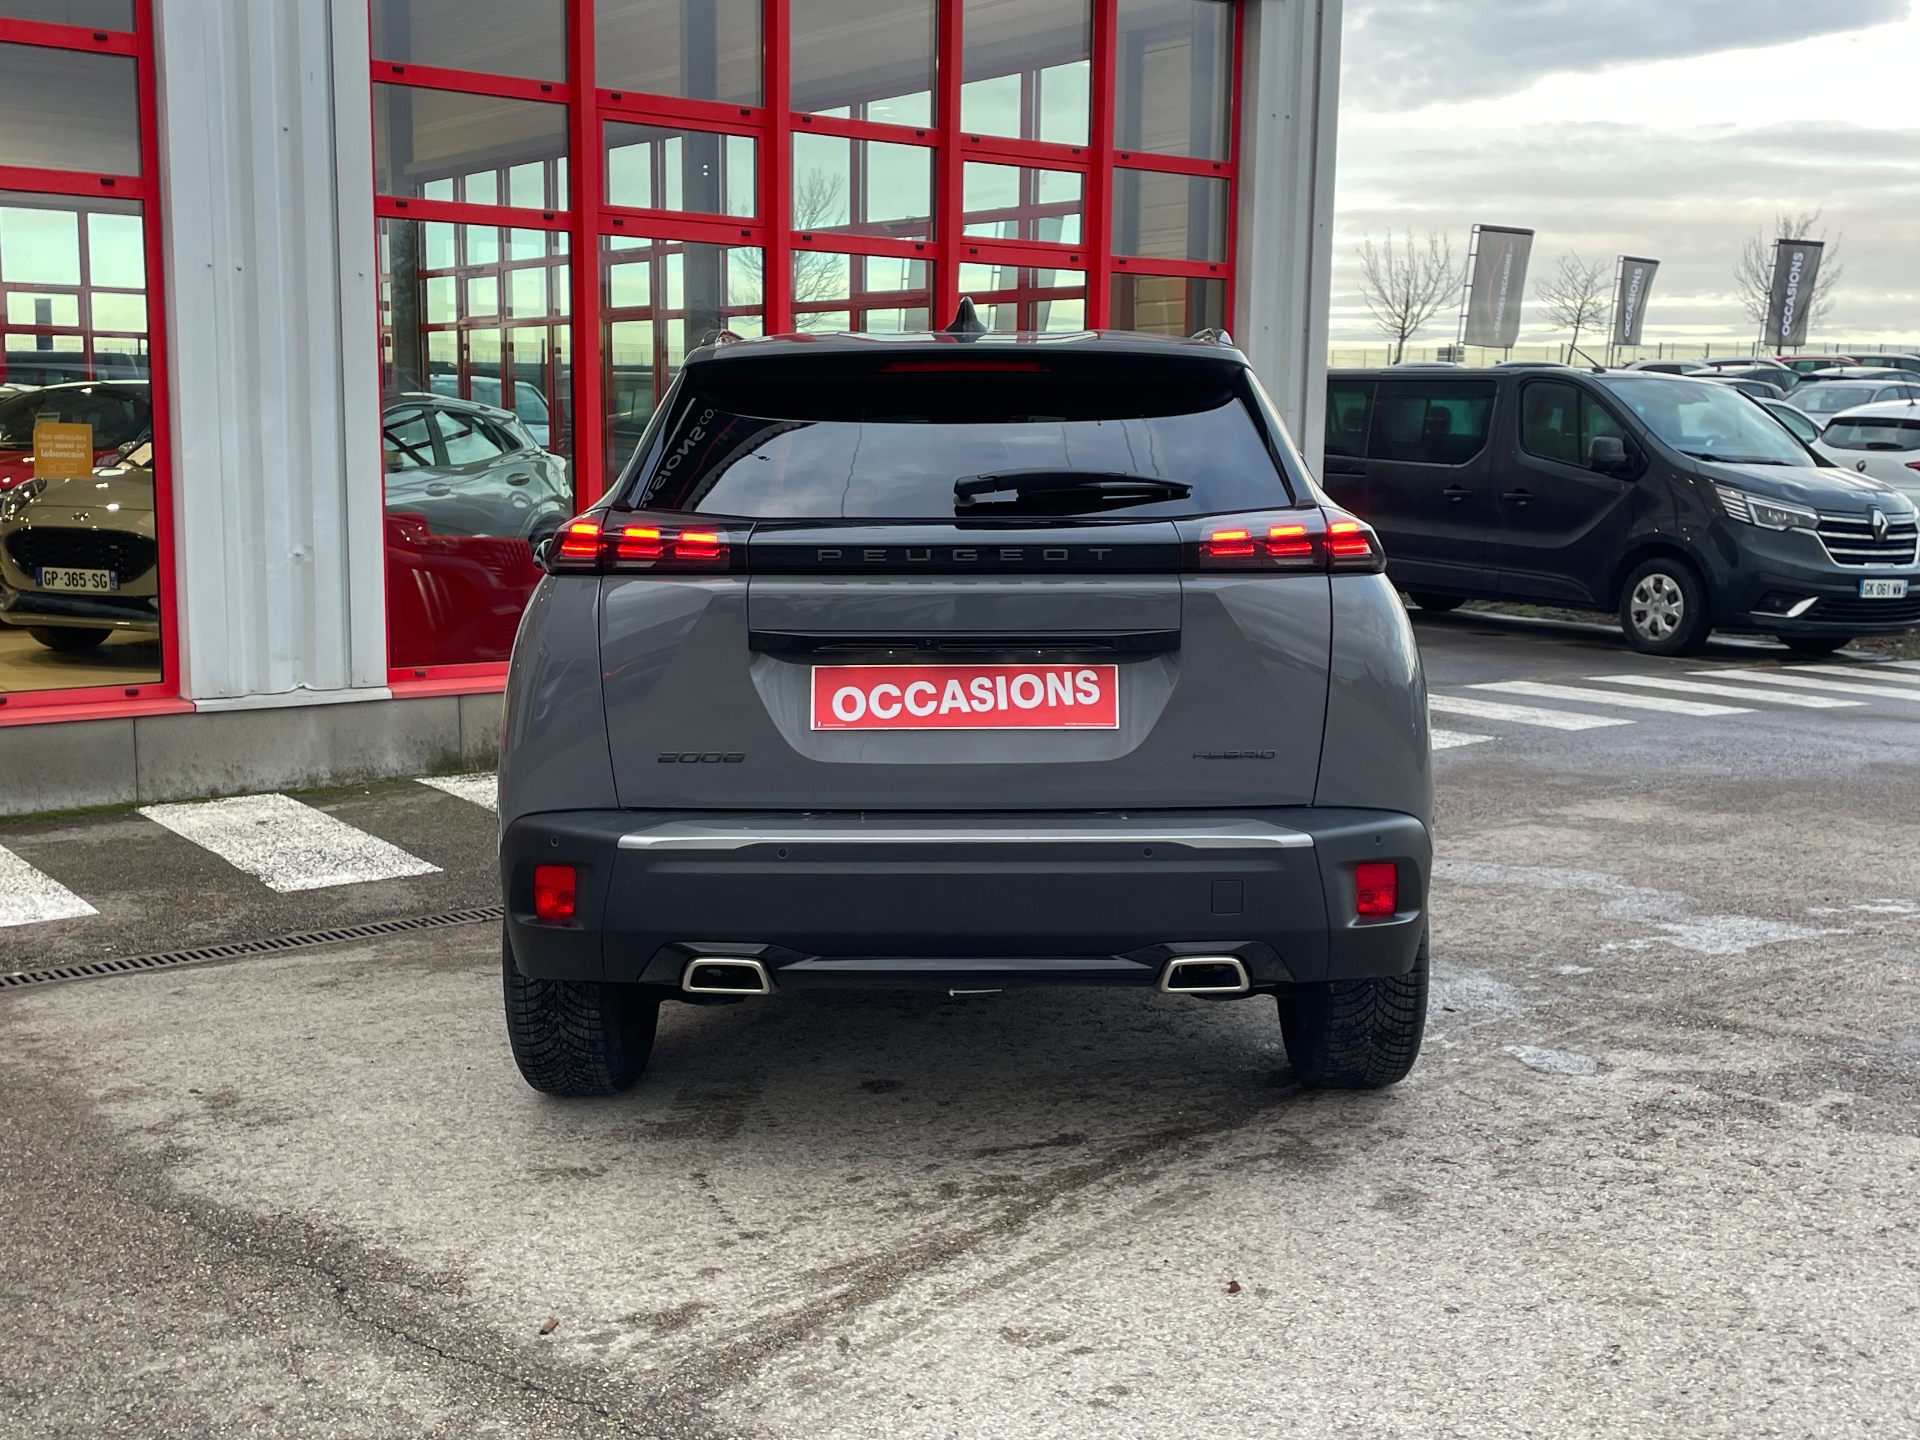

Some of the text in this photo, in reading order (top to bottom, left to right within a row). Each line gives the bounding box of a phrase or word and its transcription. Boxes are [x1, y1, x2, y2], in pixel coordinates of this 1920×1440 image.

[1500, 253, 1513, 296] OCCASIONS
[1781, 251, 1804, 336] OCCASIONS
[1624, 267, 1643, 337] OCCASIONS
[55, 441, 75, 449] aussi
[41, 449, 85, 458] leboncoin
[817, 549, 1112, 562] PEUGEOT
[43, 570, 108, 589] GP-365-SG
[832, 669, 1101, 722] OCCASIONS
[657, 751, 746, 763] 2008
[1192, 748, 1277, 760] HYBRID
